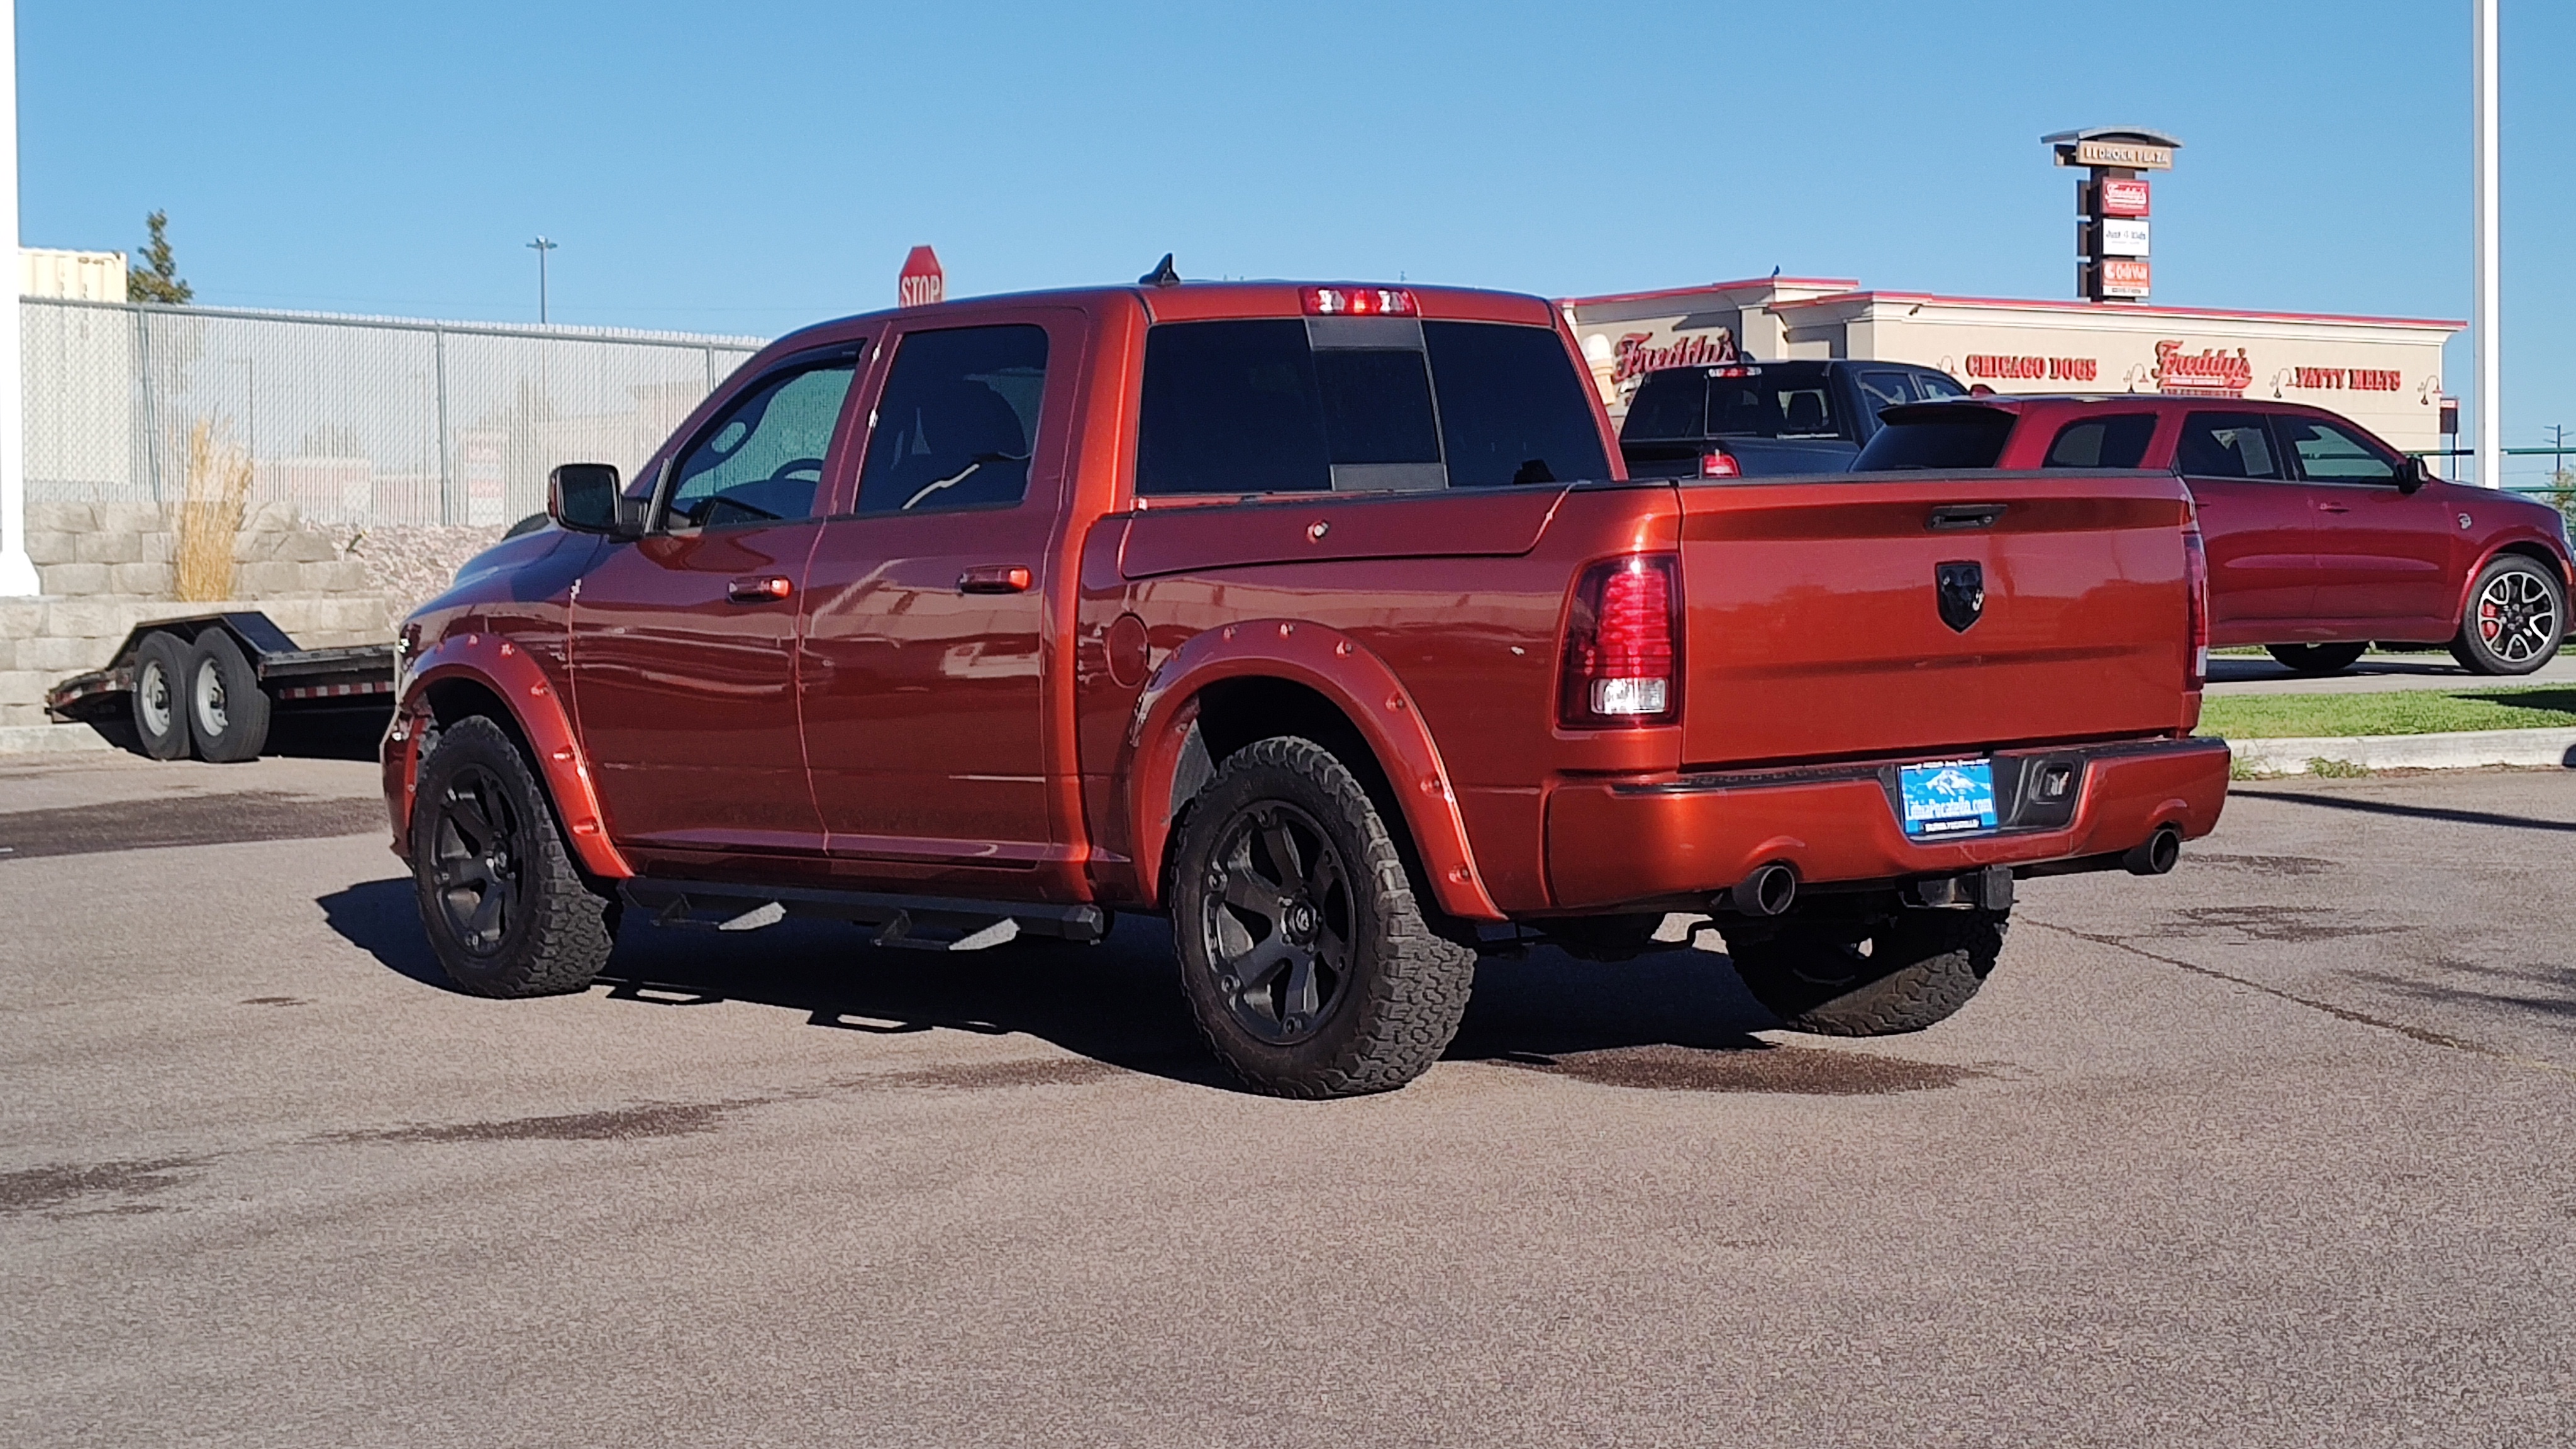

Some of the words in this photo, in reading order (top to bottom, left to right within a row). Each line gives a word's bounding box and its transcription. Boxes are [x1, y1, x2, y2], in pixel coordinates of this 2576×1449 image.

[2135, 151, 2168, 164] PLAZA
[901, 275, 941, 307] STOP
[1966, 355, 2046, 379] CHICAGO
[2049, 357, 2097, 380] DOGS
[2151, 340, 2251, 384] Freddy's
[2295, 367, 2346, 390] PATTY
[2348, 369, 2401, 391] MELTS
